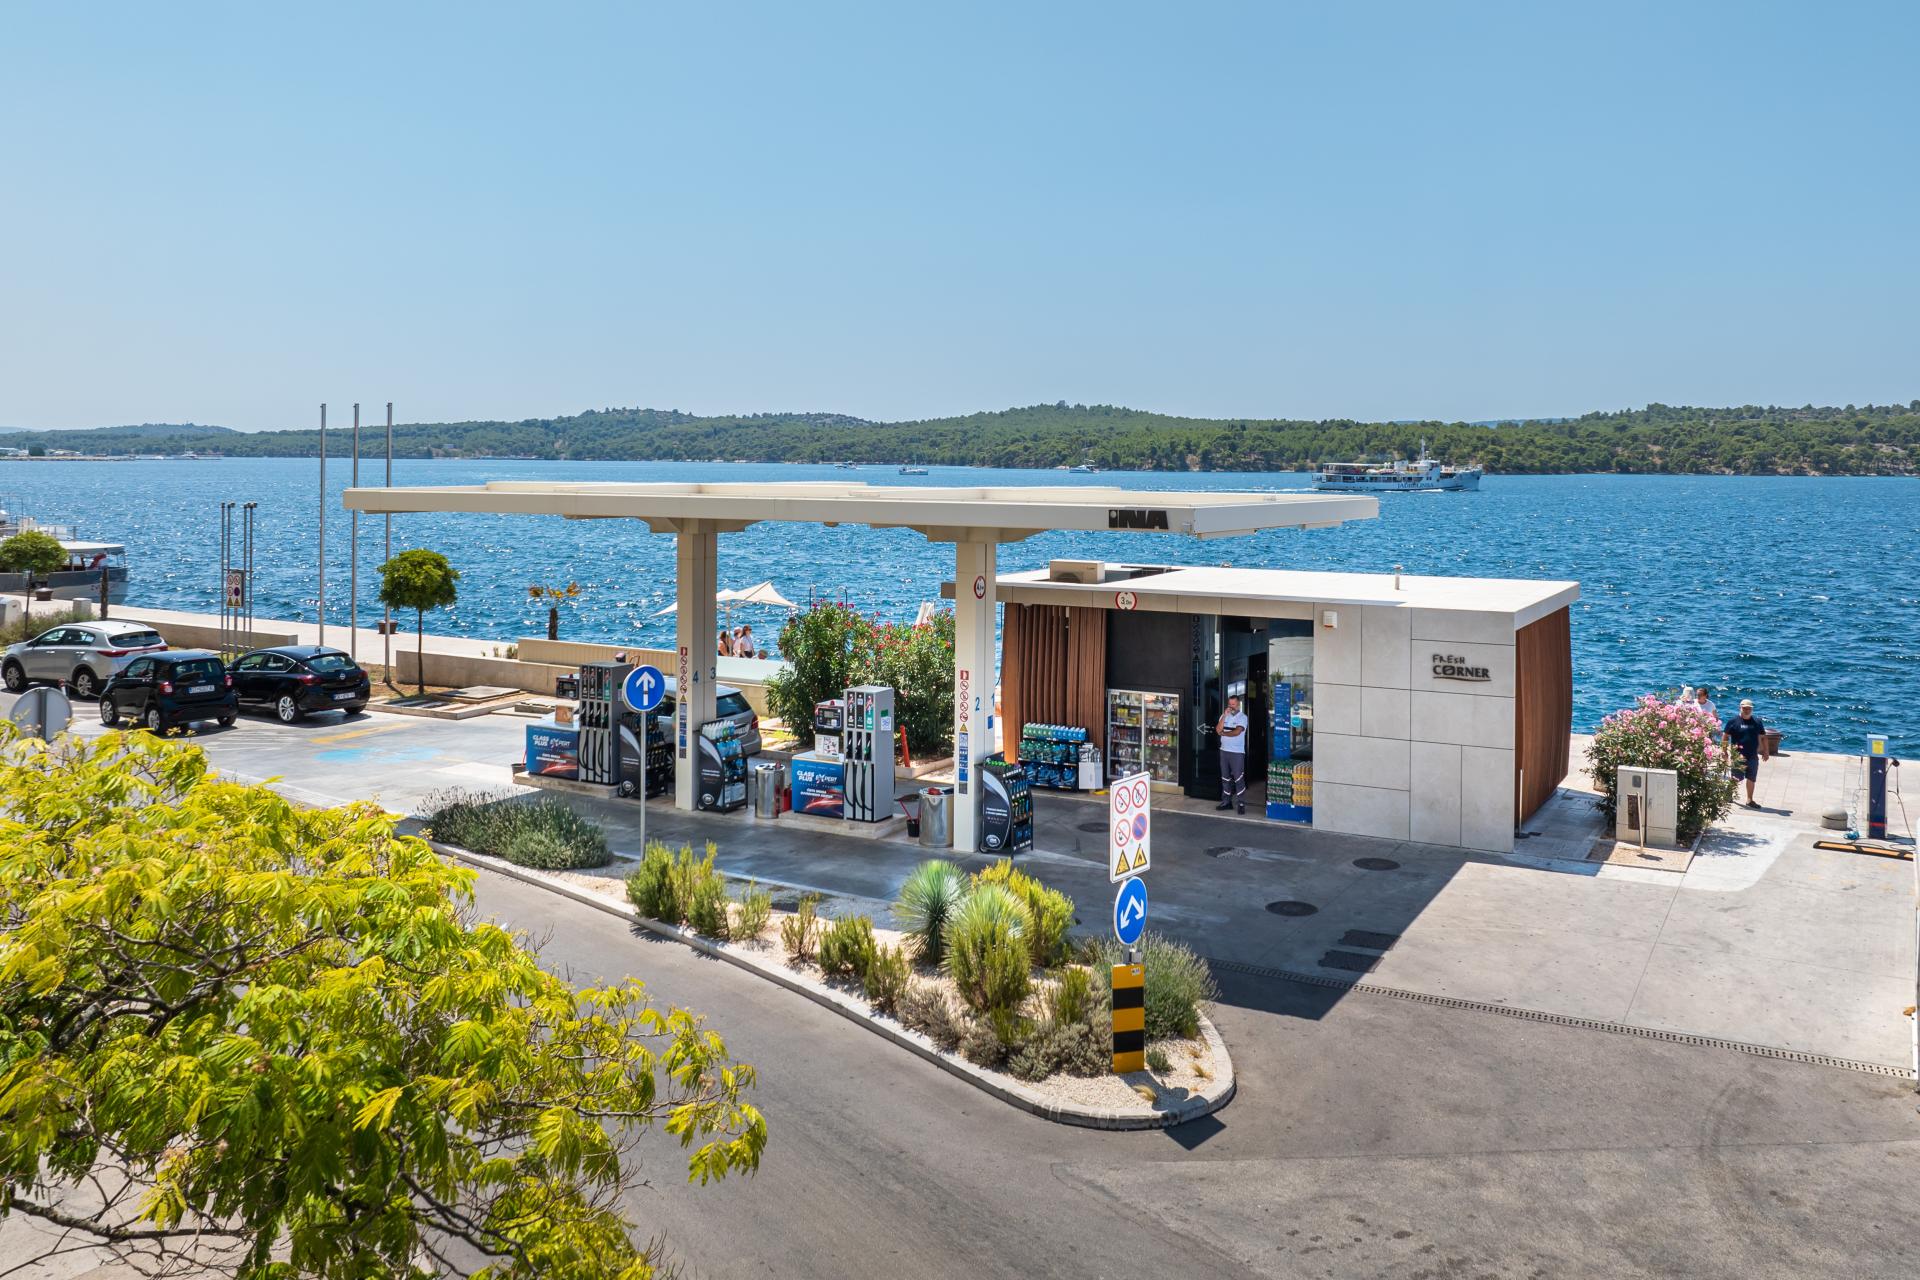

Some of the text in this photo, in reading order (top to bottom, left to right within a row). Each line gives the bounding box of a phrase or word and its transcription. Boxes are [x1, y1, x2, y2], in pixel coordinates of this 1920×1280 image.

[1108, 509, 1169, 529] INA
[1432, 654, 1465, 664] FRESH
[693, 671, 699, 683] 4
[710, 667, 716, 679] 3
[1432, 665, 1490, 678] CORNER
[975, 697, 980, 711] 2
[991, 693, 995, 707] 1
